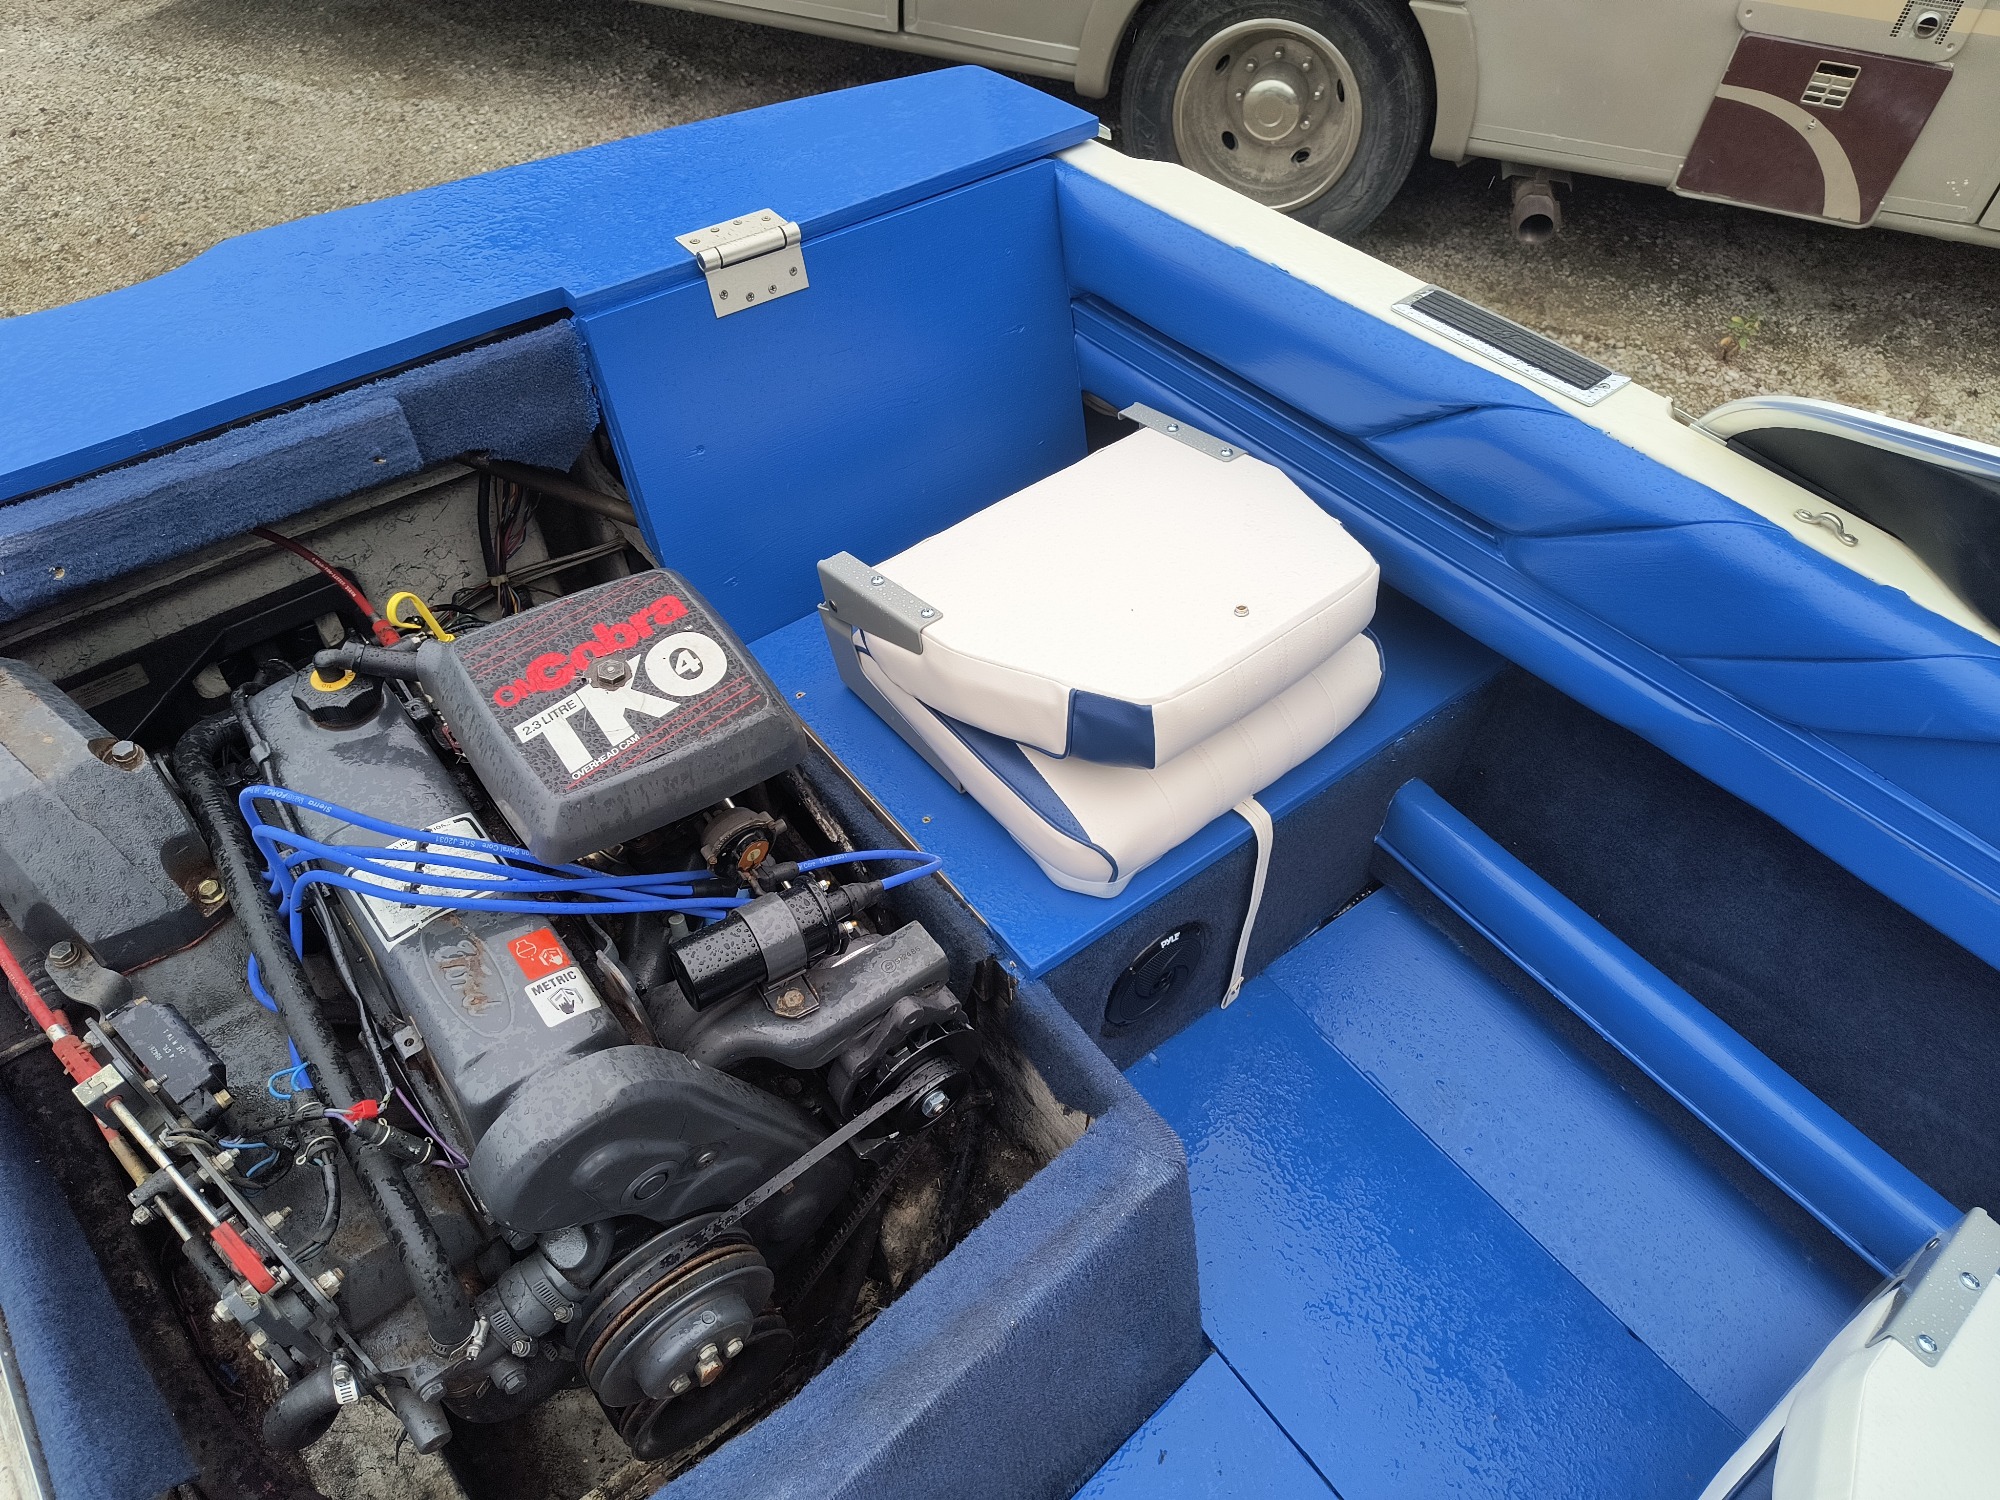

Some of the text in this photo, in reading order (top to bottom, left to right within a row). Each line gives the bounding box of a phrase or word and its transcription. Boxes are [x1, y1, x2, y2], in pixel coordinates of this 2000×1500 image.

[675, 649, 701, 676] 4
[513, 631, 727, 772] TKO
[522, 699, 577, 736] 2.3 LITRE
[571, 733, 641, 780] OVERHEAD CAM
[307, 800, 333, 813] Sierra
[435, 835, 459, 845] J2031
[459, 839, 476, 848] SAE
[482, 842, 499, 852] Core
[1160, 932, 1180, 948] PYLE
[530, 970, 577, 996] METRIC
